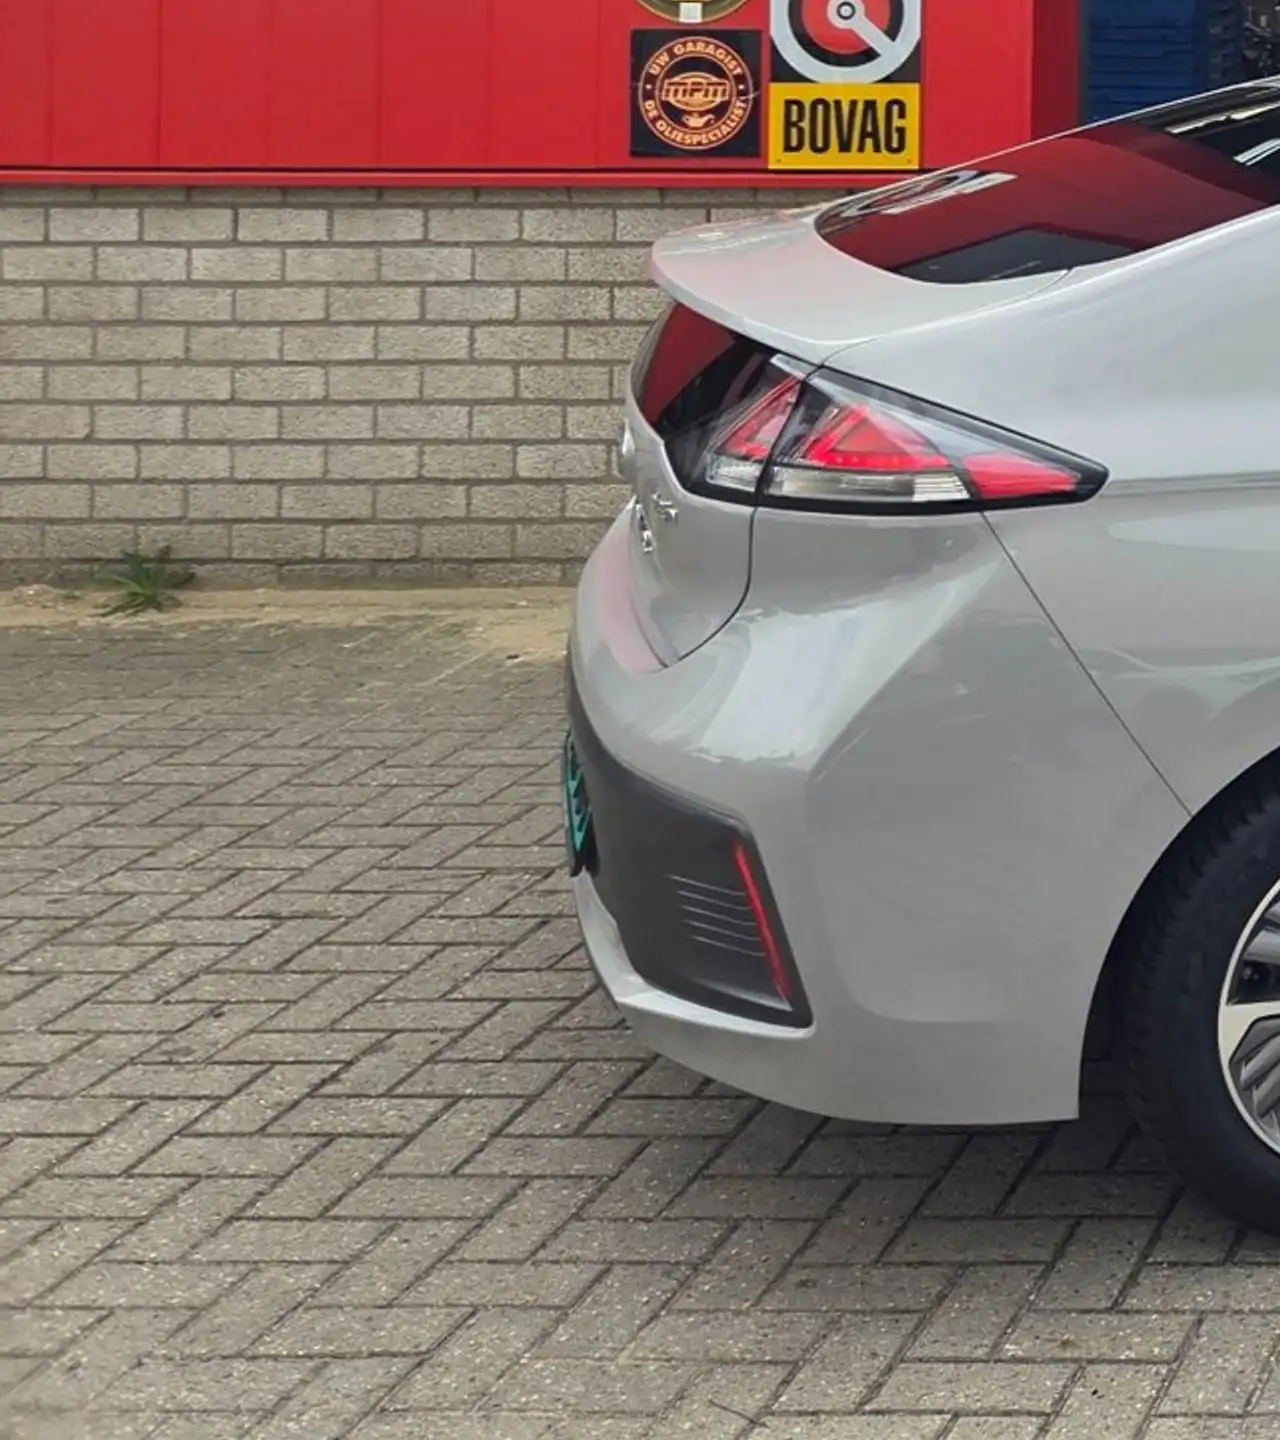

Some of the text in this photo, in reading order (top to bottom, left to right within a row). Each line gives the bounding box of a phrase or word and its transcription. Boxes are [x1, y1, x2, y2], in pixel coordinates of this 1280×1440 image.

[648, 42, 742, 75] UW GARAGIST
[644, 100, 747, 145] DE OLIESPECIALIST
[782, 98, 907, 154] BOVAG
